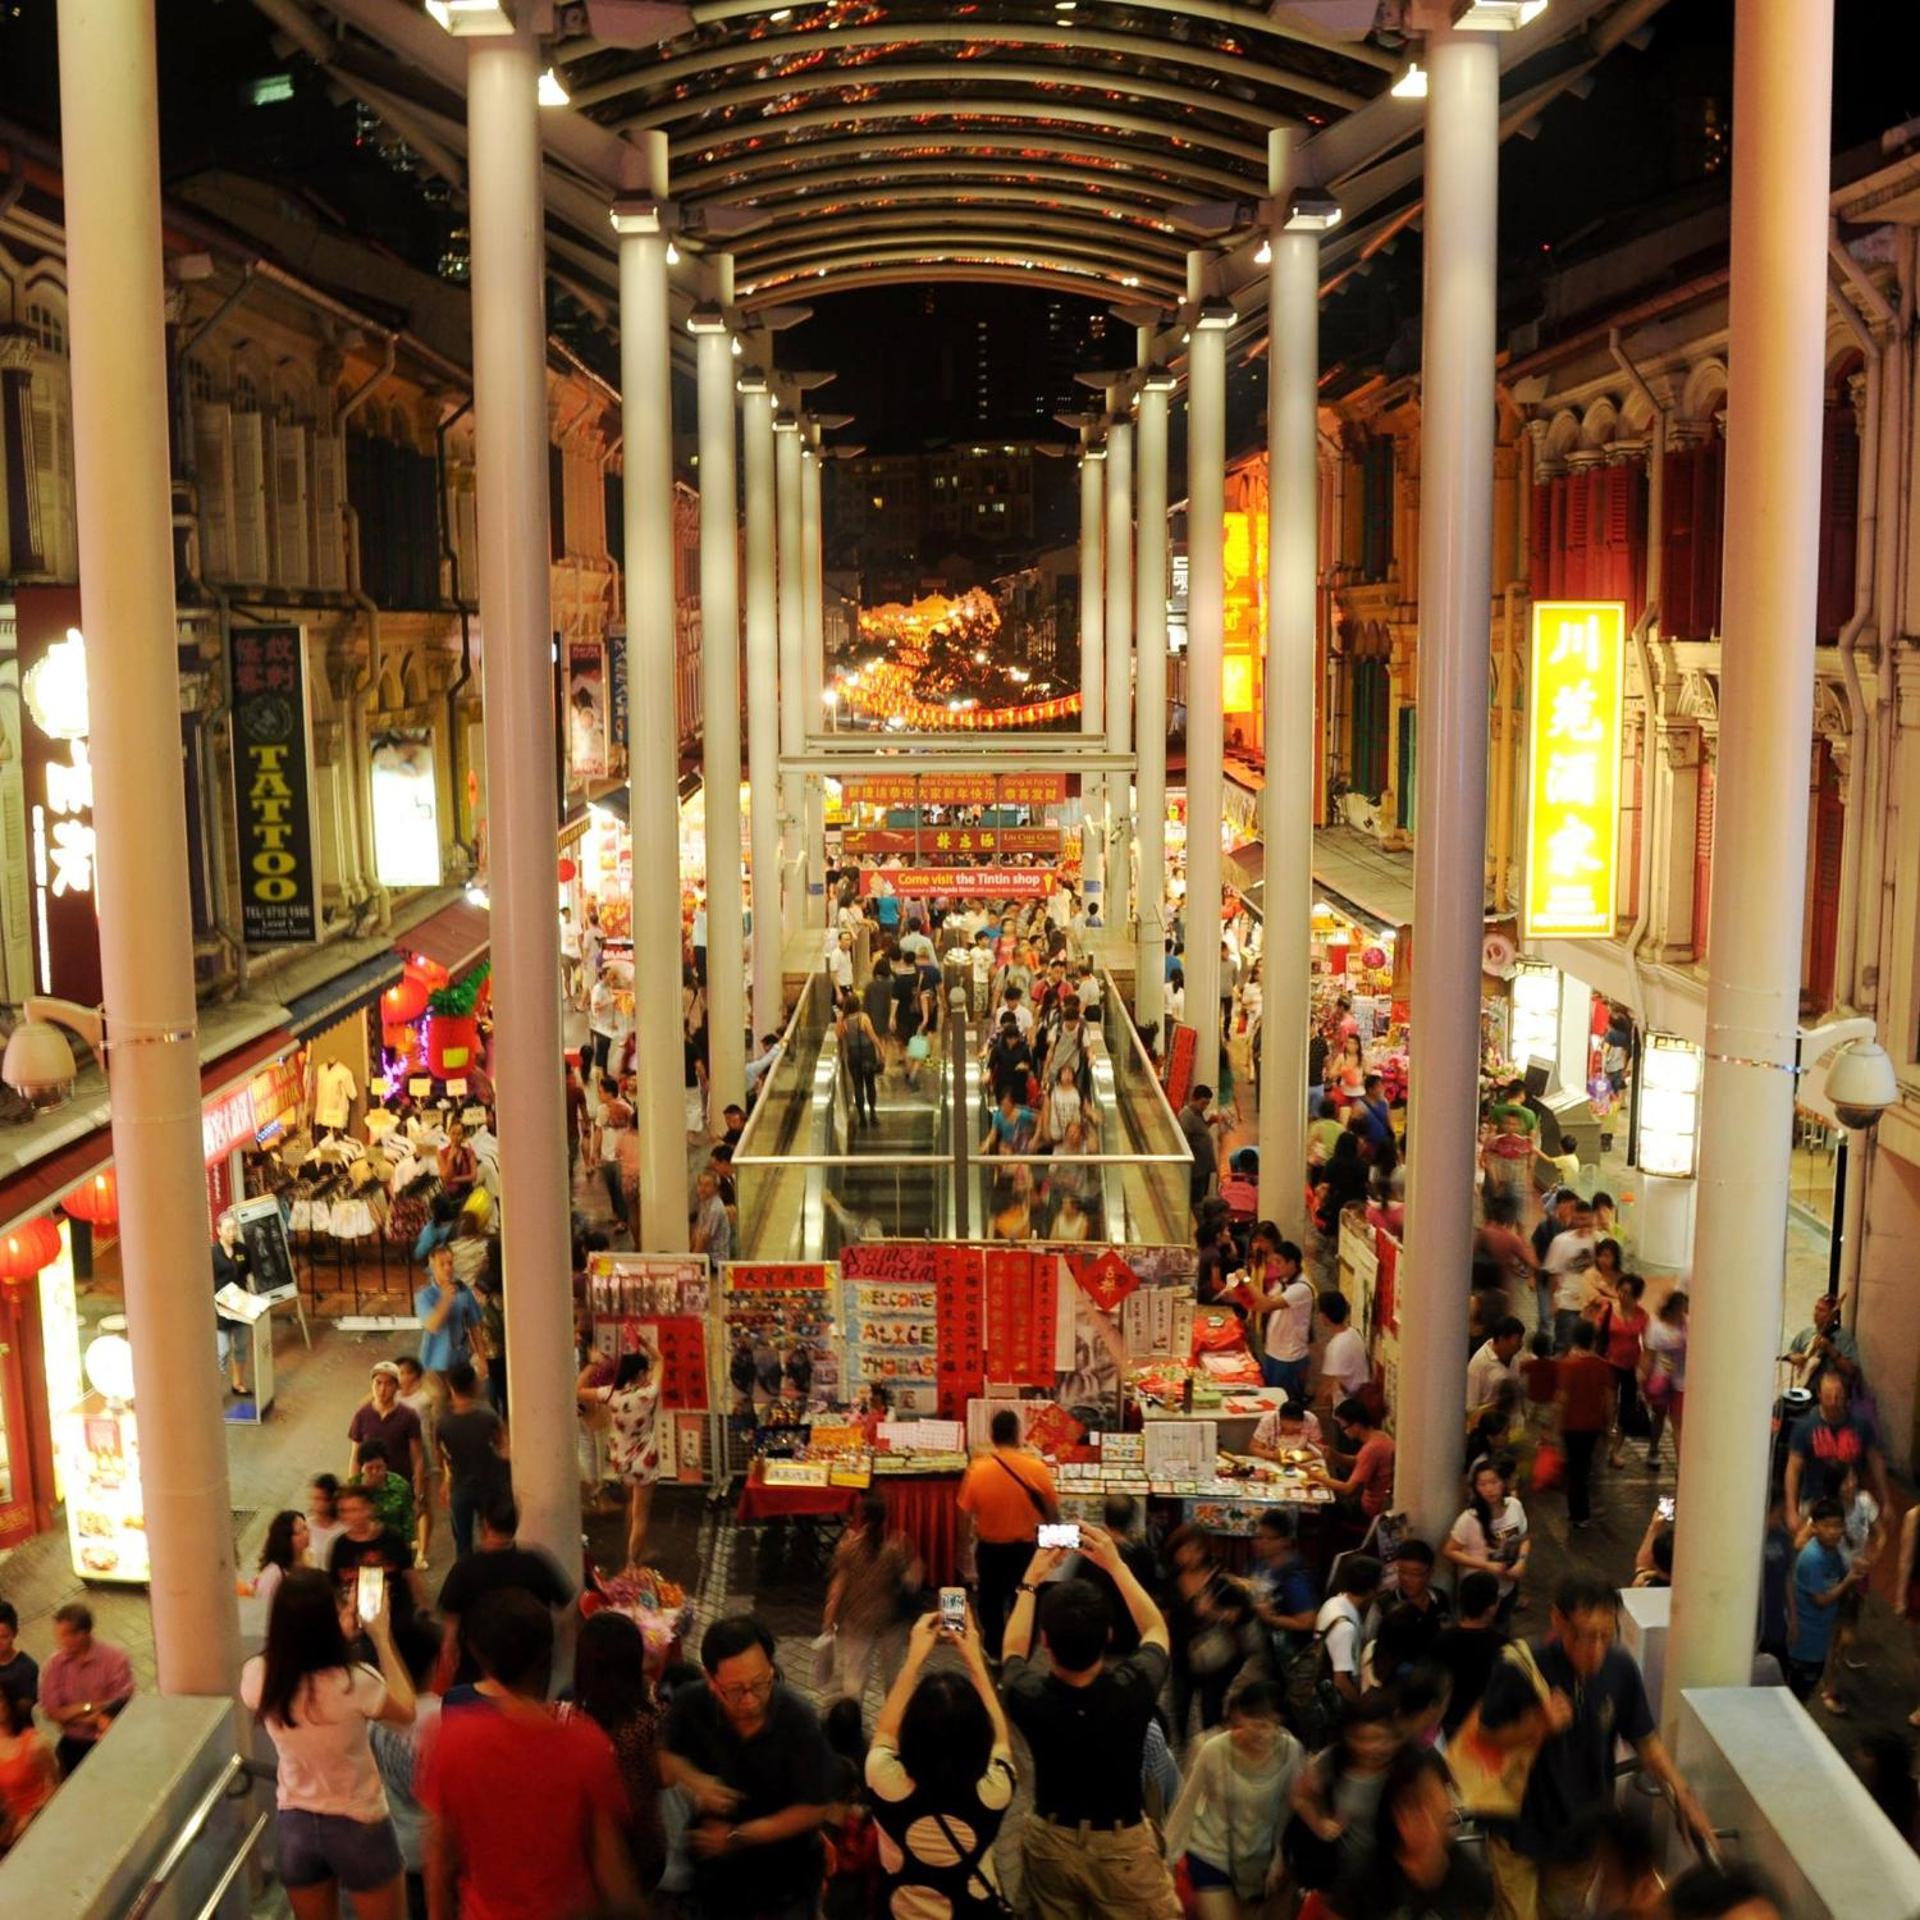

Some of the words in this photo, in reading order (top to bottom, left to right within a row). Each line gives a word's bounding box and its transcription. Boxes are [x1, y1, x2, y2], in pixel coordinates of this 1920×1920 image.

[248, 745, 298, 901] TATTOO
[898, 873, 930, 885] Come
[931, 873, 954, 885] visit
[955, 873, 976, 885] the
[977, 873, 1010, 885] Tintin
[1012, 873, 1041, 887] shop
[860, 1290, 934, 1308] WELCOME
[862, 1323, 936, 1345] ALICE
[861, 1356, 937, 1376] THOMAS
